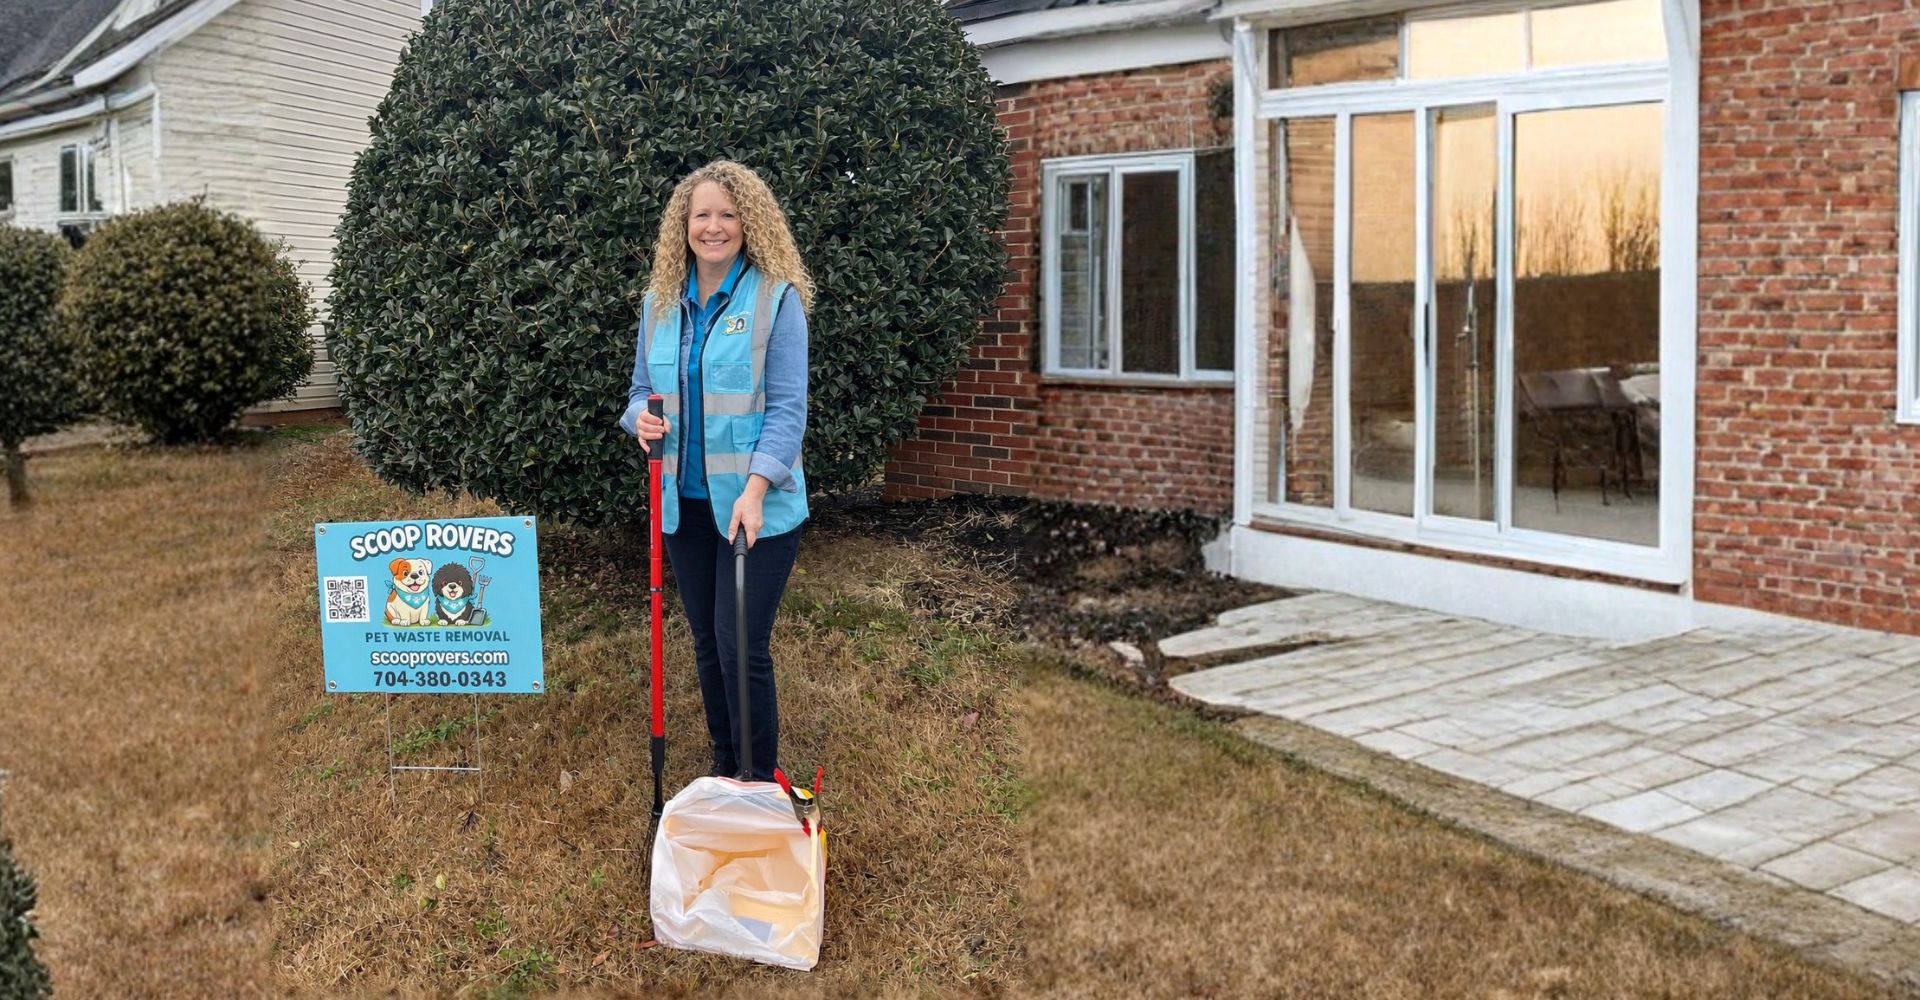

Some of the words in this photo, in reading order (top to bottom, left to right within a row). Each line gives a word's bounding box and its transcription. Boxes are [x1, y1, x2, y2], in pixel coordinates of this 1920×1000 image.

[349, 523, 422, 560] SCOOP
[425, 522, 515, 557] ROVERS
[365, 631, 388, 643] PET
[393, 631, 441, 643] WASTE
[445, 630, 510, 642] REMOVAL
[370, 650, 509, 668] scooprovers.com
[373, 670, 507, 687] 704-380-0343
